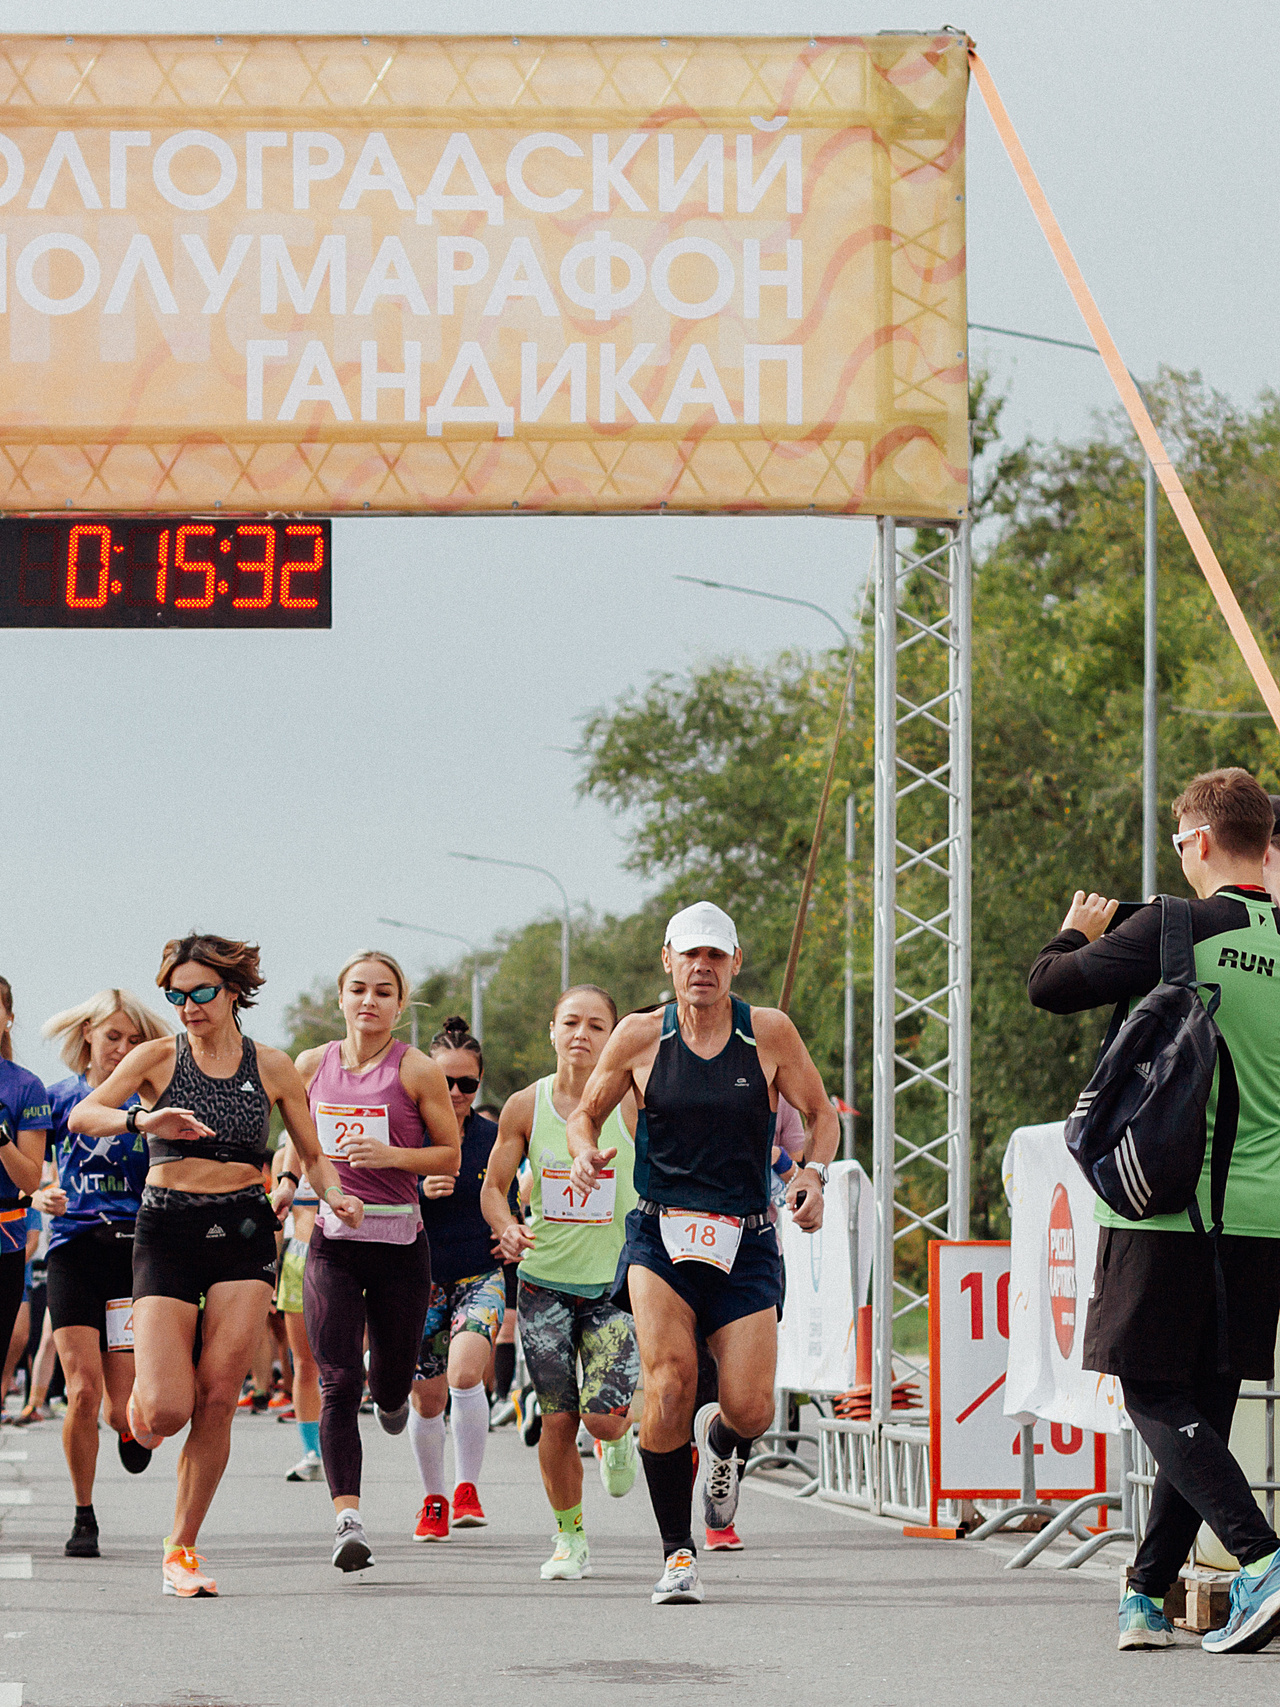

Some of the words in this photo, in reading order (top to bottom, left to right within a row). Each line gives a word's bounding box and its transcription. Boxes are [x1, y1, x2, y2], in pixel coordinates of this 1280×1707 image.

[247, 339, 803, 437] ГАНДИКАП
[66, 525, 324, 608] 0:15:32
[1218, 947, 1274, 977] RUN
[685, 1223, 717, 1247] 18
